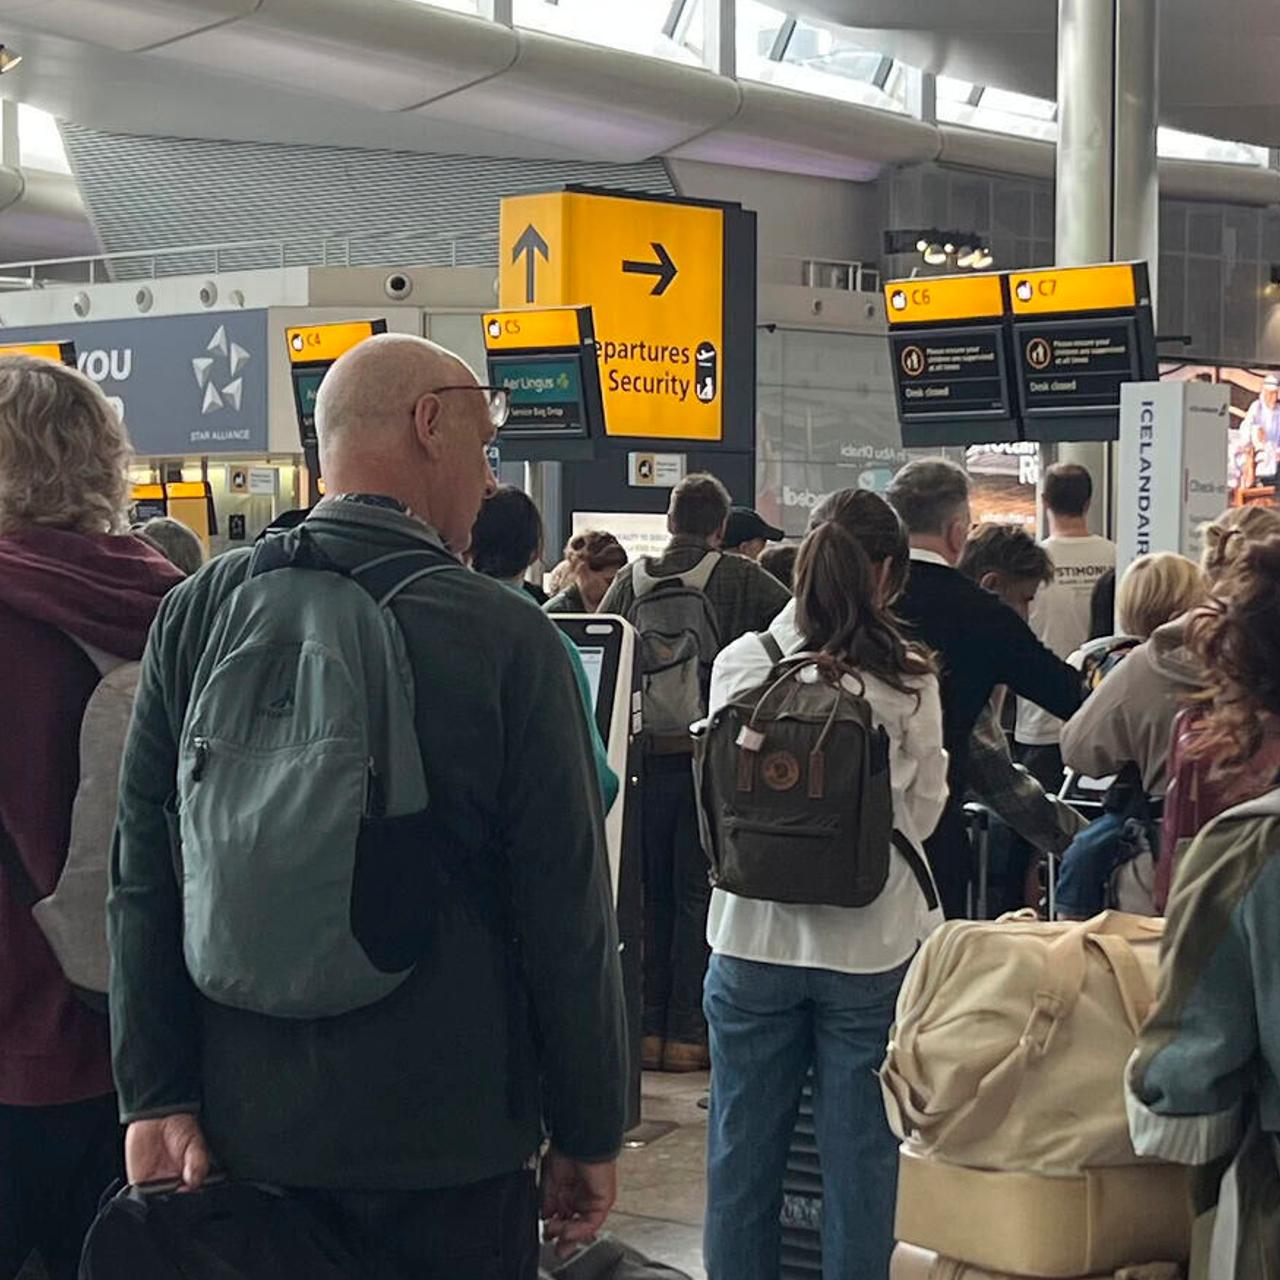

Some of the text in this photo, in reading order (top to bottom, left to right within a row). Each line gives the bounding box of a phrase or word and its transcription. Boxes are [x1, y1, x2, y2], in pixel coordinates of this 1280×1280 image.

[1038, 280, 1056, 296] C7
[912, 289, 930, 305] C6
[505, 320, 520, 334] C5
[595, 341, 690, 364] epartures
[503, 378, 555, 392] Aer Lingus
[609, 369, 691, 402] Security
[190, 430, 250, 442] STAR ALLIANCE
[1137, 401, 1154, 555] ICELANDAIR
